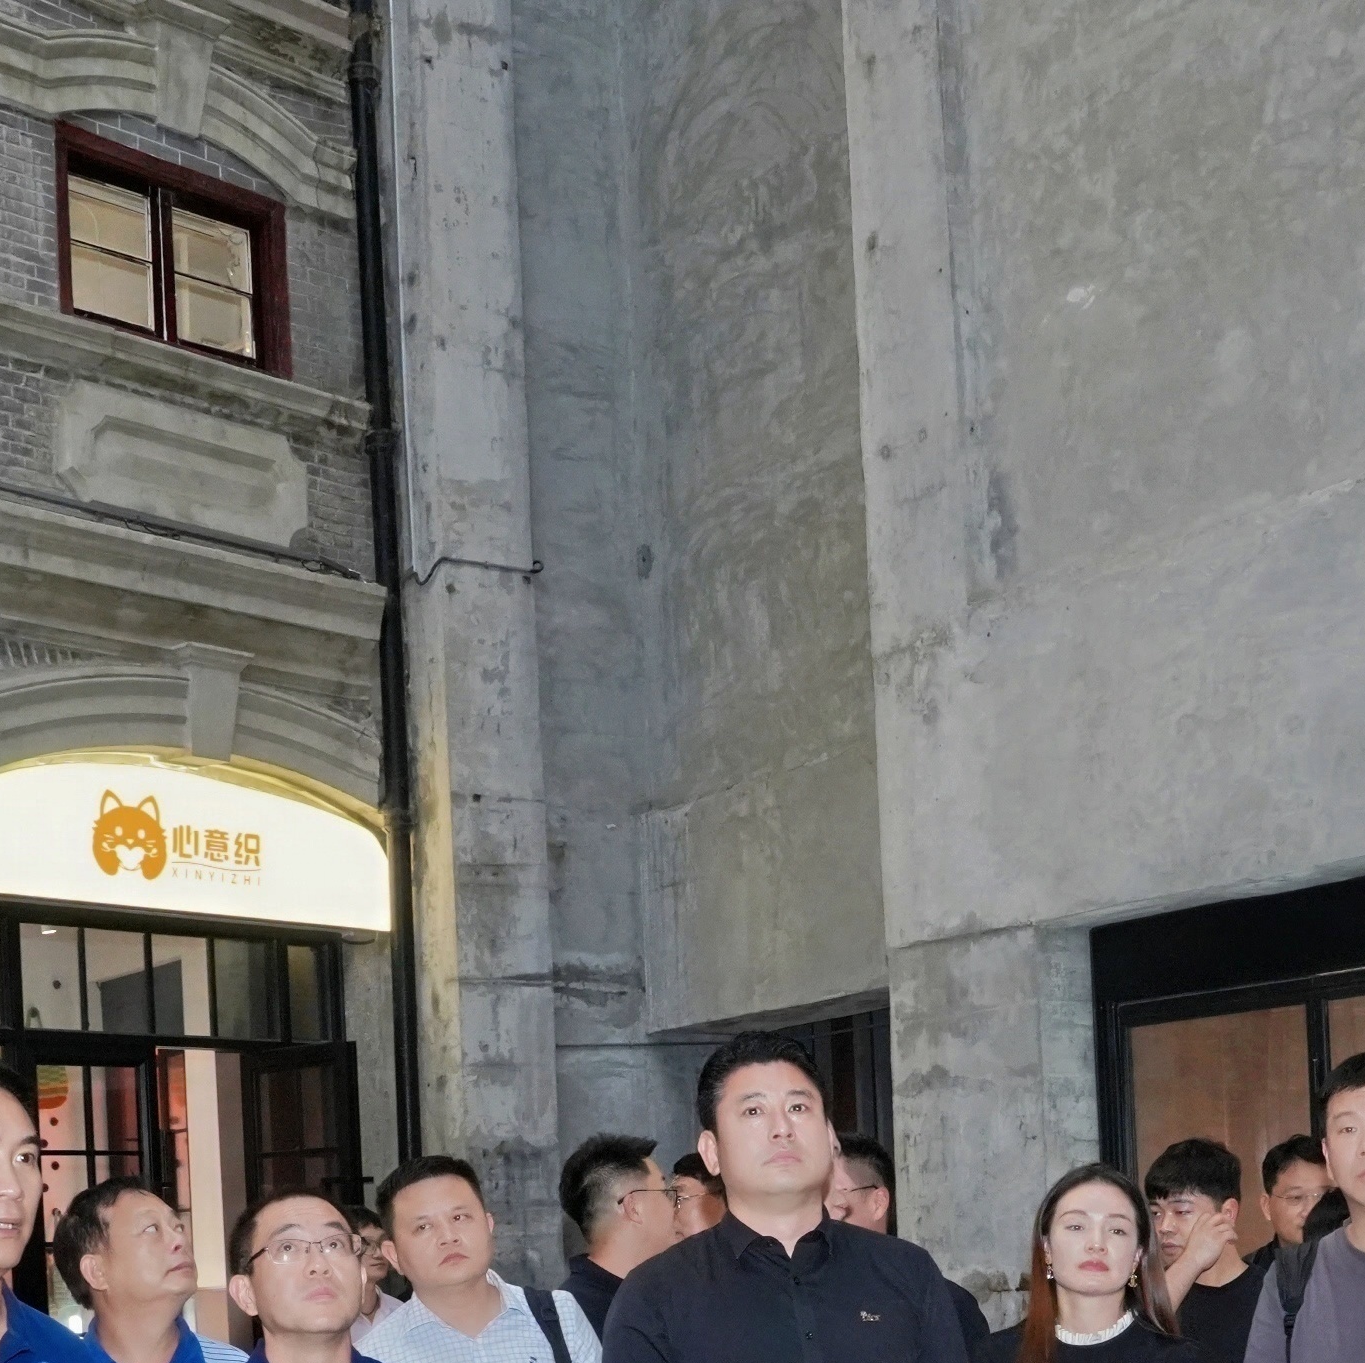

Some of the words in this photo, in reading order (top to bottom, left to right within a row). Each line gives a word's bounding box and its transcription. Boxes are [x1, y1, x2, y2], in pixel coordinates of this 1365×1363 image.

[172, 825, 260, 867] 心意织
[171, 867, 261, 886] XINYIZHI
